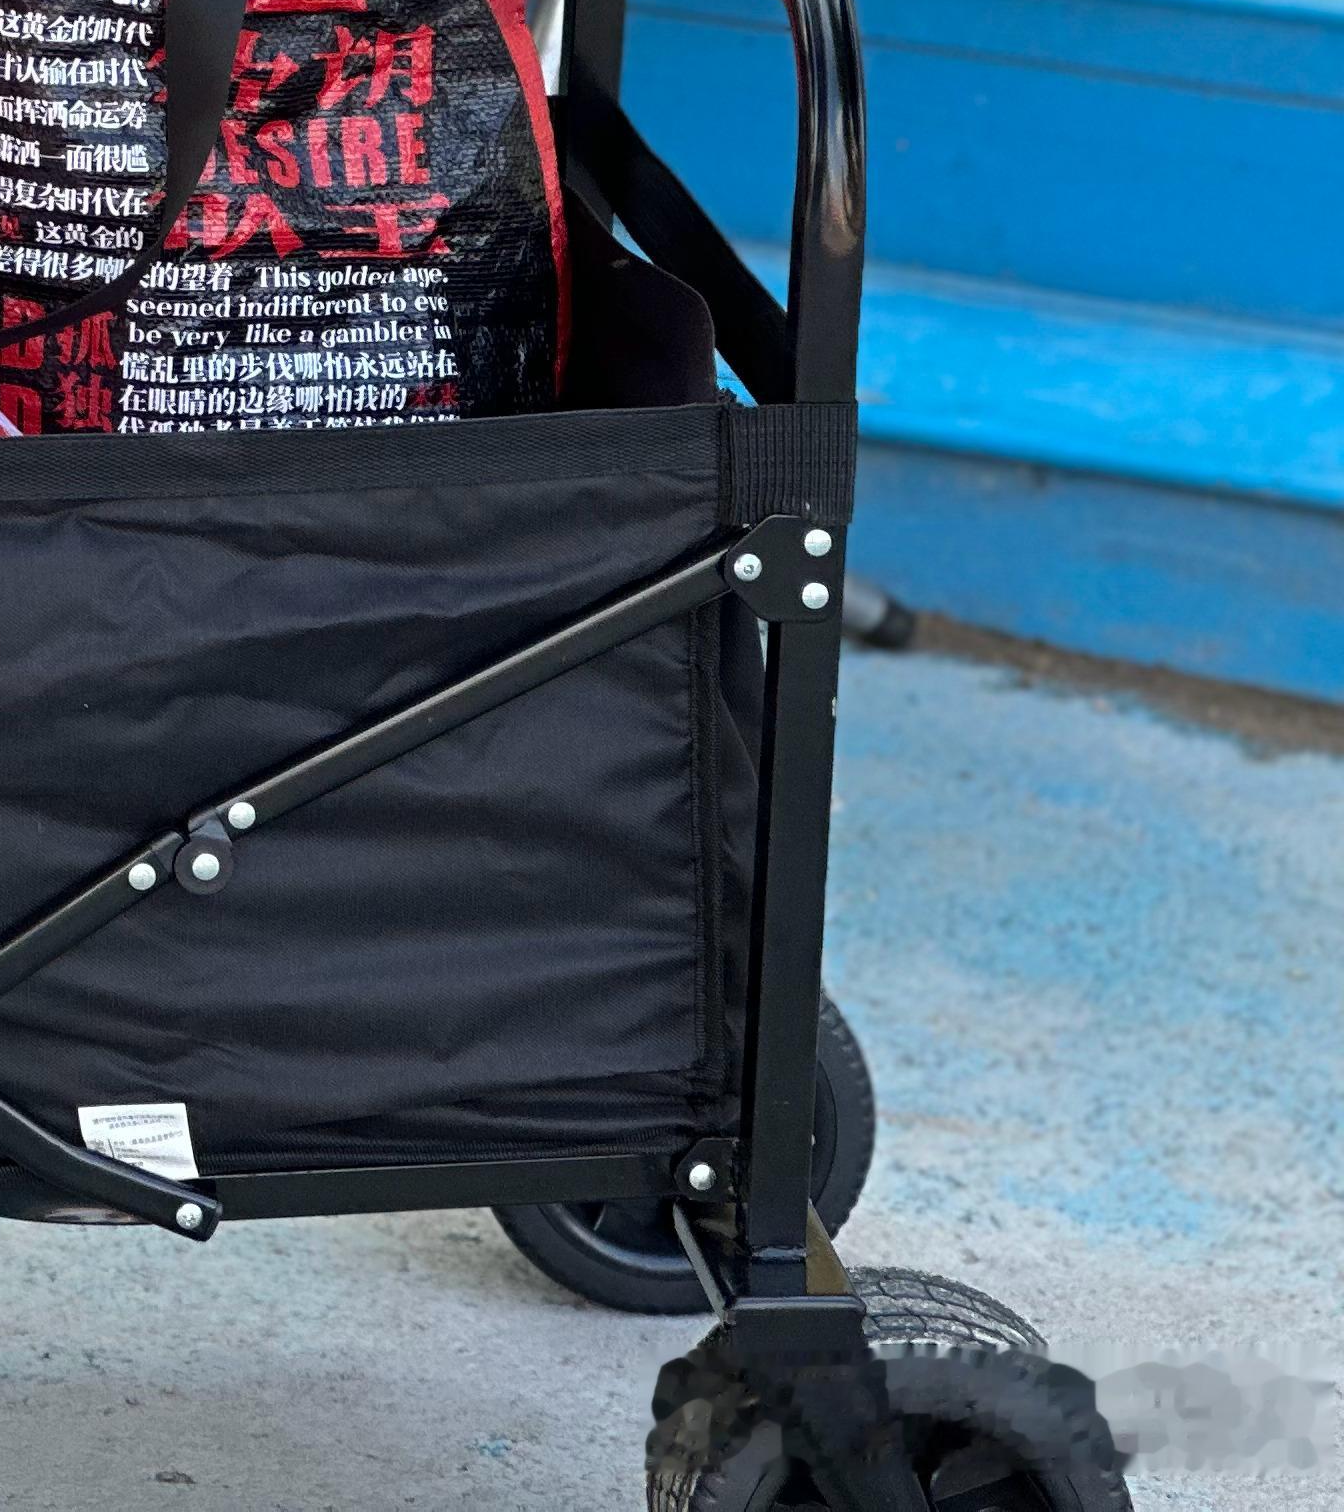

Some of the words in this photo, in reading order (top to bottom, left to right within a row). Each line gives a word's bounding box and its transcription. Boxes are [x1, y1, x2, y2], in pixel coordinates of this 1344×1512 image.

[198, 112, 432, 189] ESIRE
[255, 264, 312, 289] This
[317, 264, 395, 292] golden
[126, 295, 231, 319] seemed
[238, 293, 373, 319] indifferent
[381, 293, 407, 316] to
[129, 321, 162, 346] be
[171, 329, 231, 350] very
[246, 323, 293, 345] like
[298, 328, 315, 345] a
[320, 320, 427, 349] gambler
[433, 318, 453, 341] in
